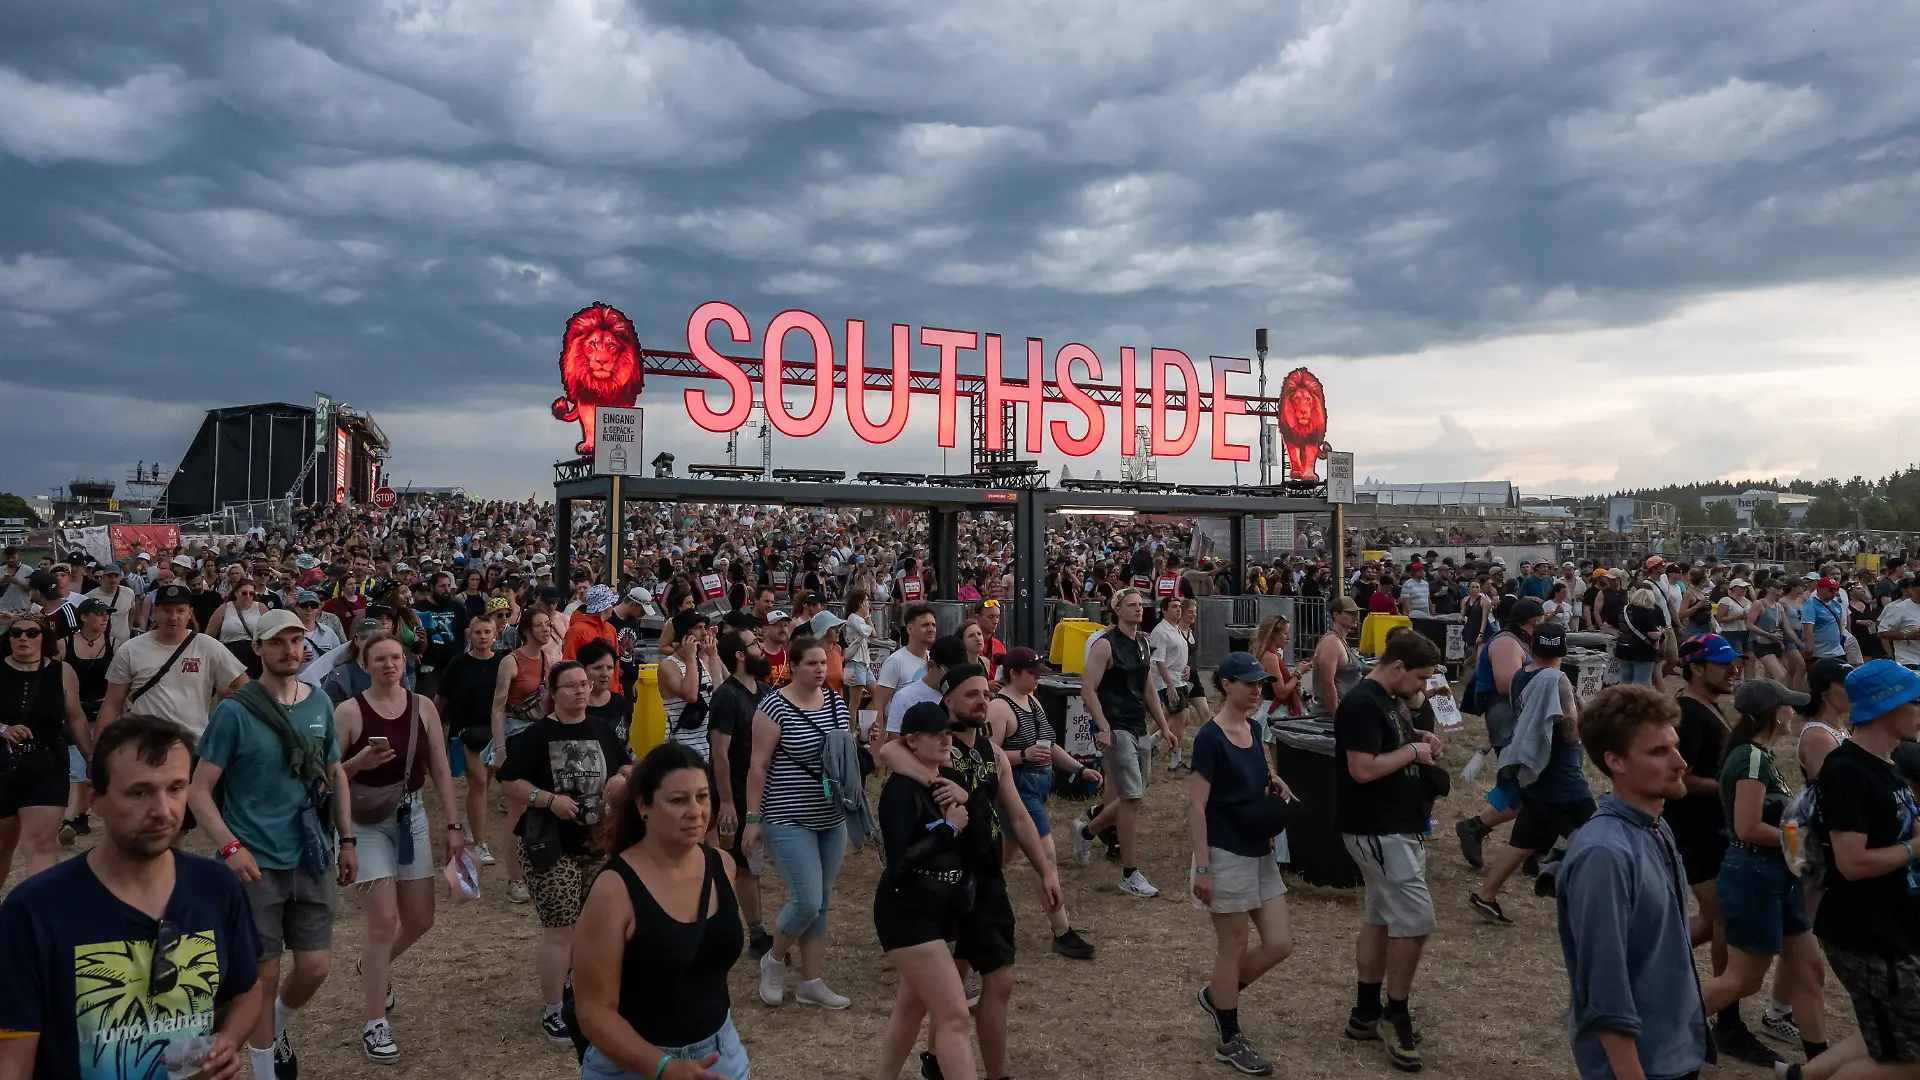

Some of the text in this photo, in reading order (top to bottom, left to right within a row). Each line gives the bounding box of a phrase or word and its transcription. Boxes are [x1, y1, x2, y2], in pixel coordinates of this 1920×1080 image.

[684, 301, 1251, 462] SOUTHSIDE
[603, 413, 635, 425] EINGANG
[608, 425, 634, 435] GEPÄCK-
[602, 434, 635, 443] KONTROLLE
[375, 493, 395, 502] STOP
